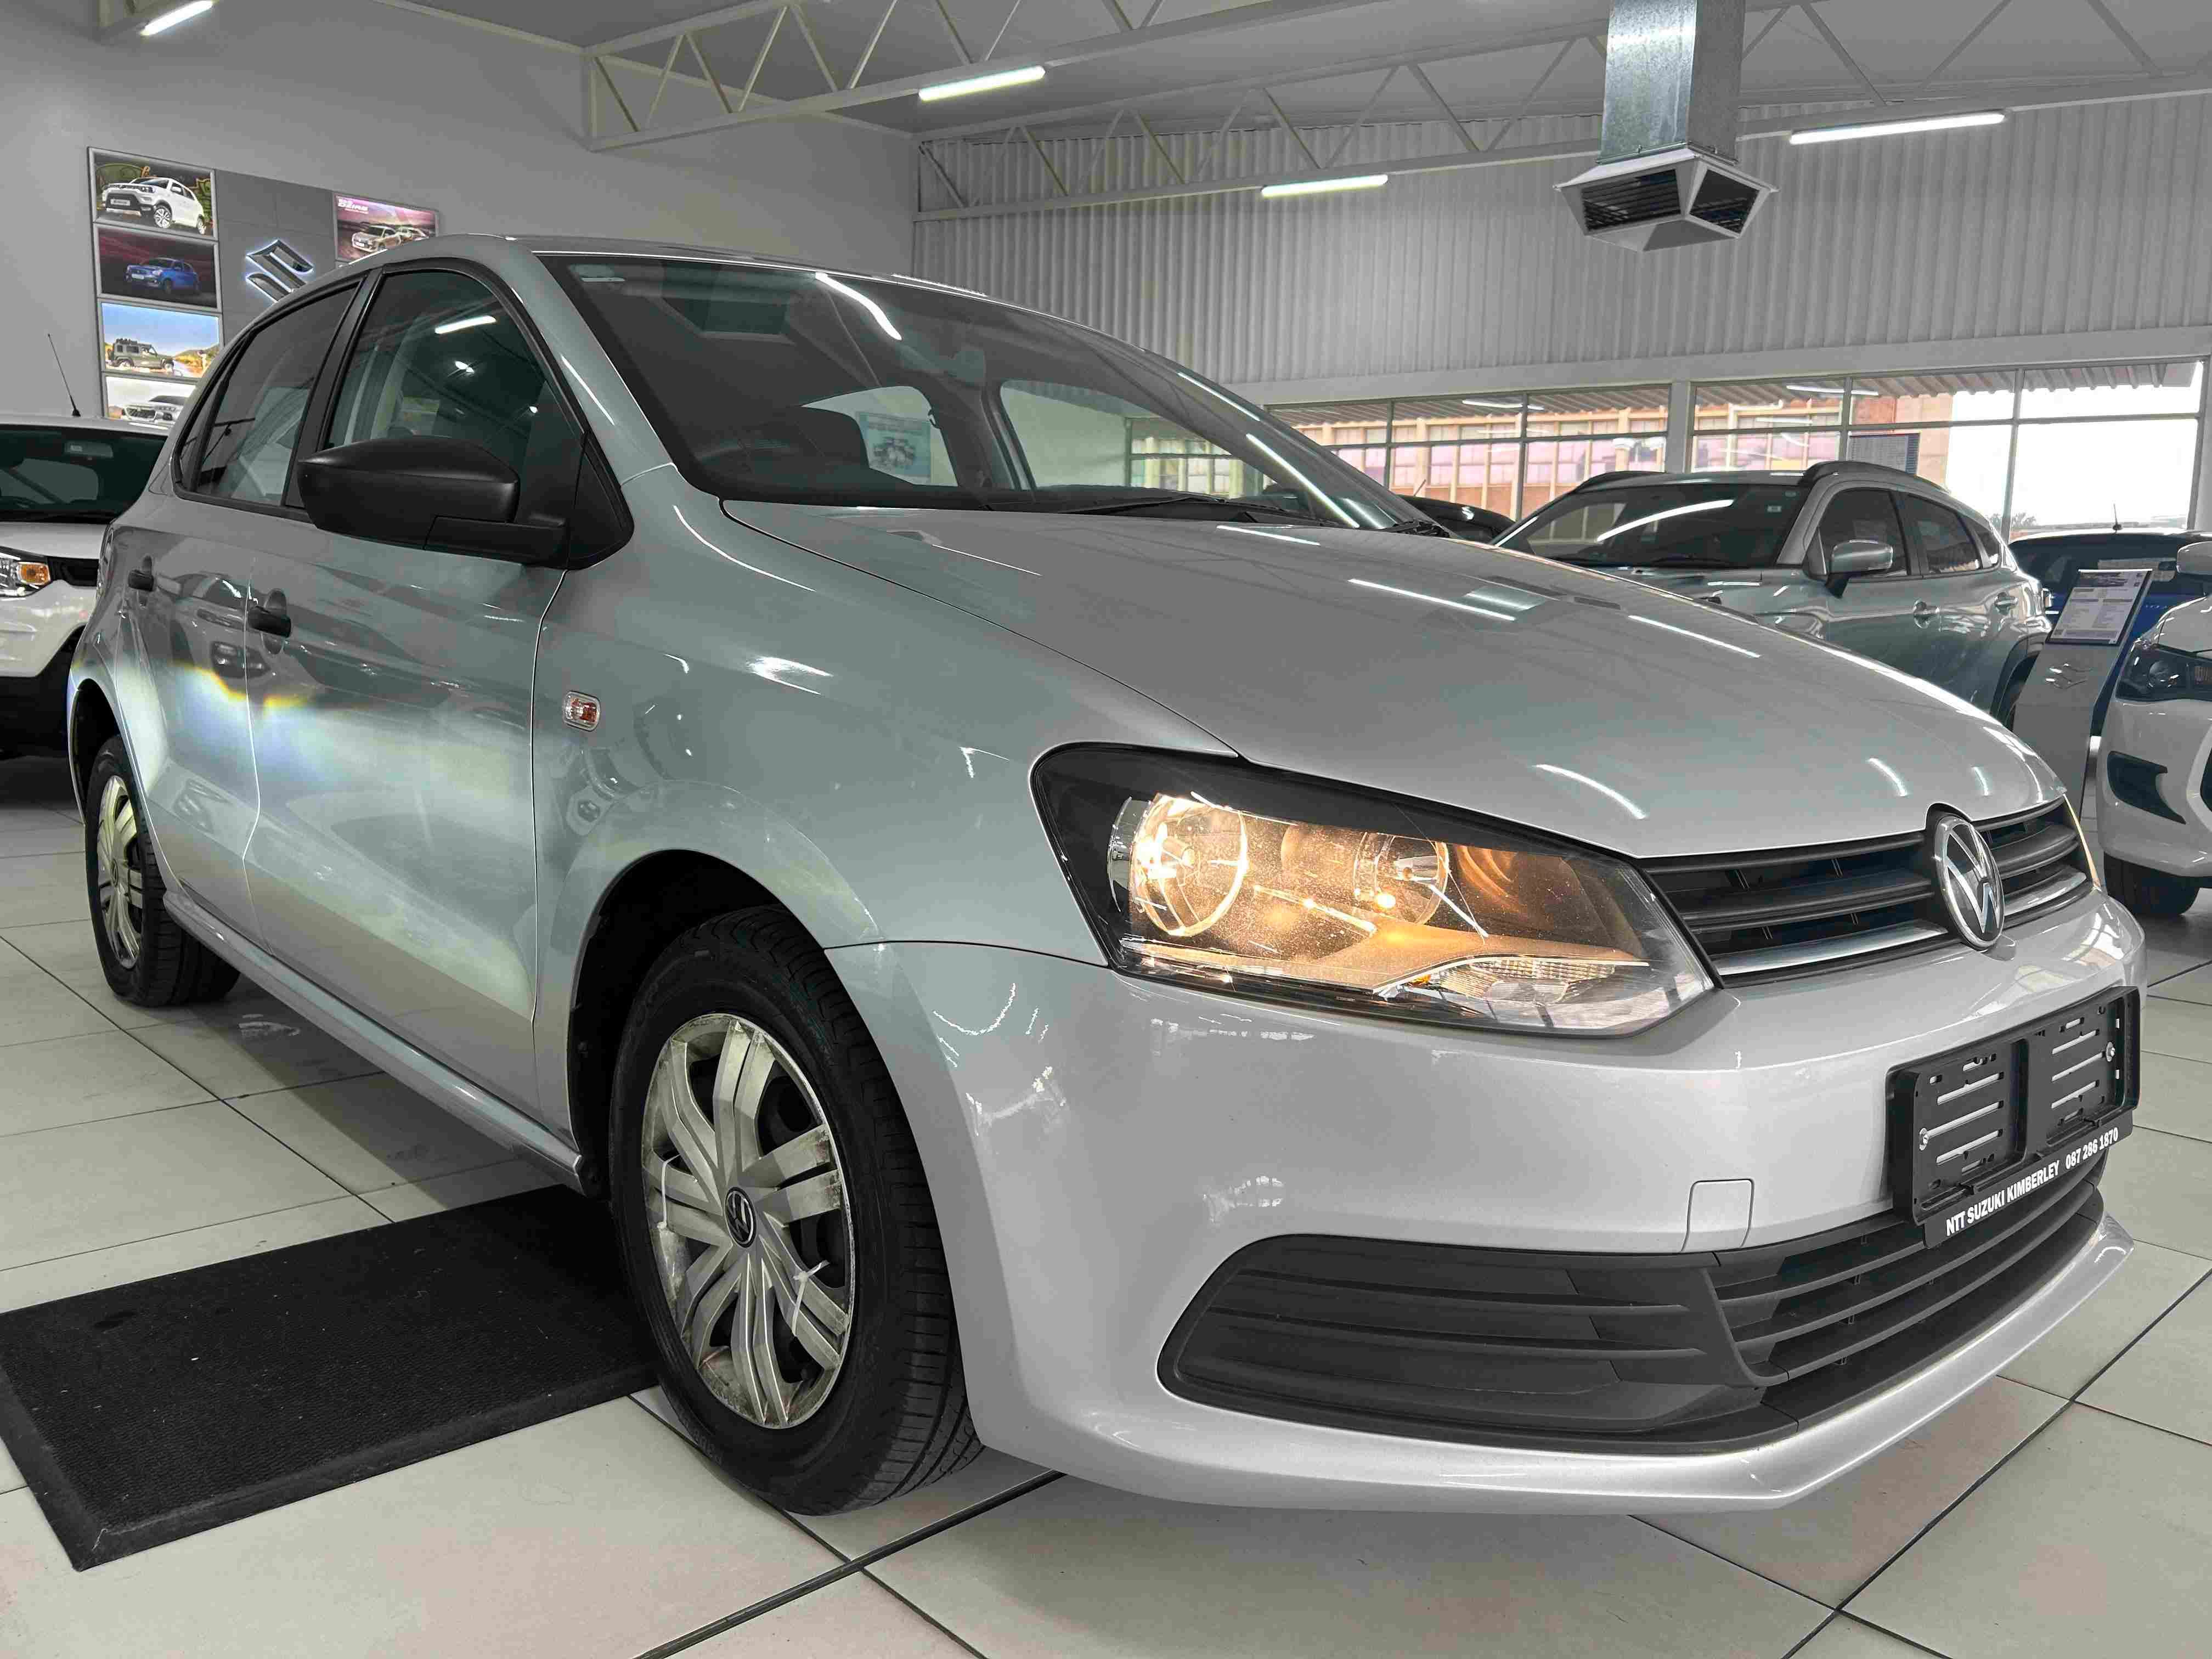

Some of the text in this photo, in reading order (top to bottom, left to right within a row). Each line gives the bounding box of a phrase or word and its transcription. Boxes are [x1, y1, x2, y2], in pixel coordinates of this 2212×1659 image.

[1946, 1127, 2119, 1237] NTT SUZUKI KIMBERLEY 087 286 1870
